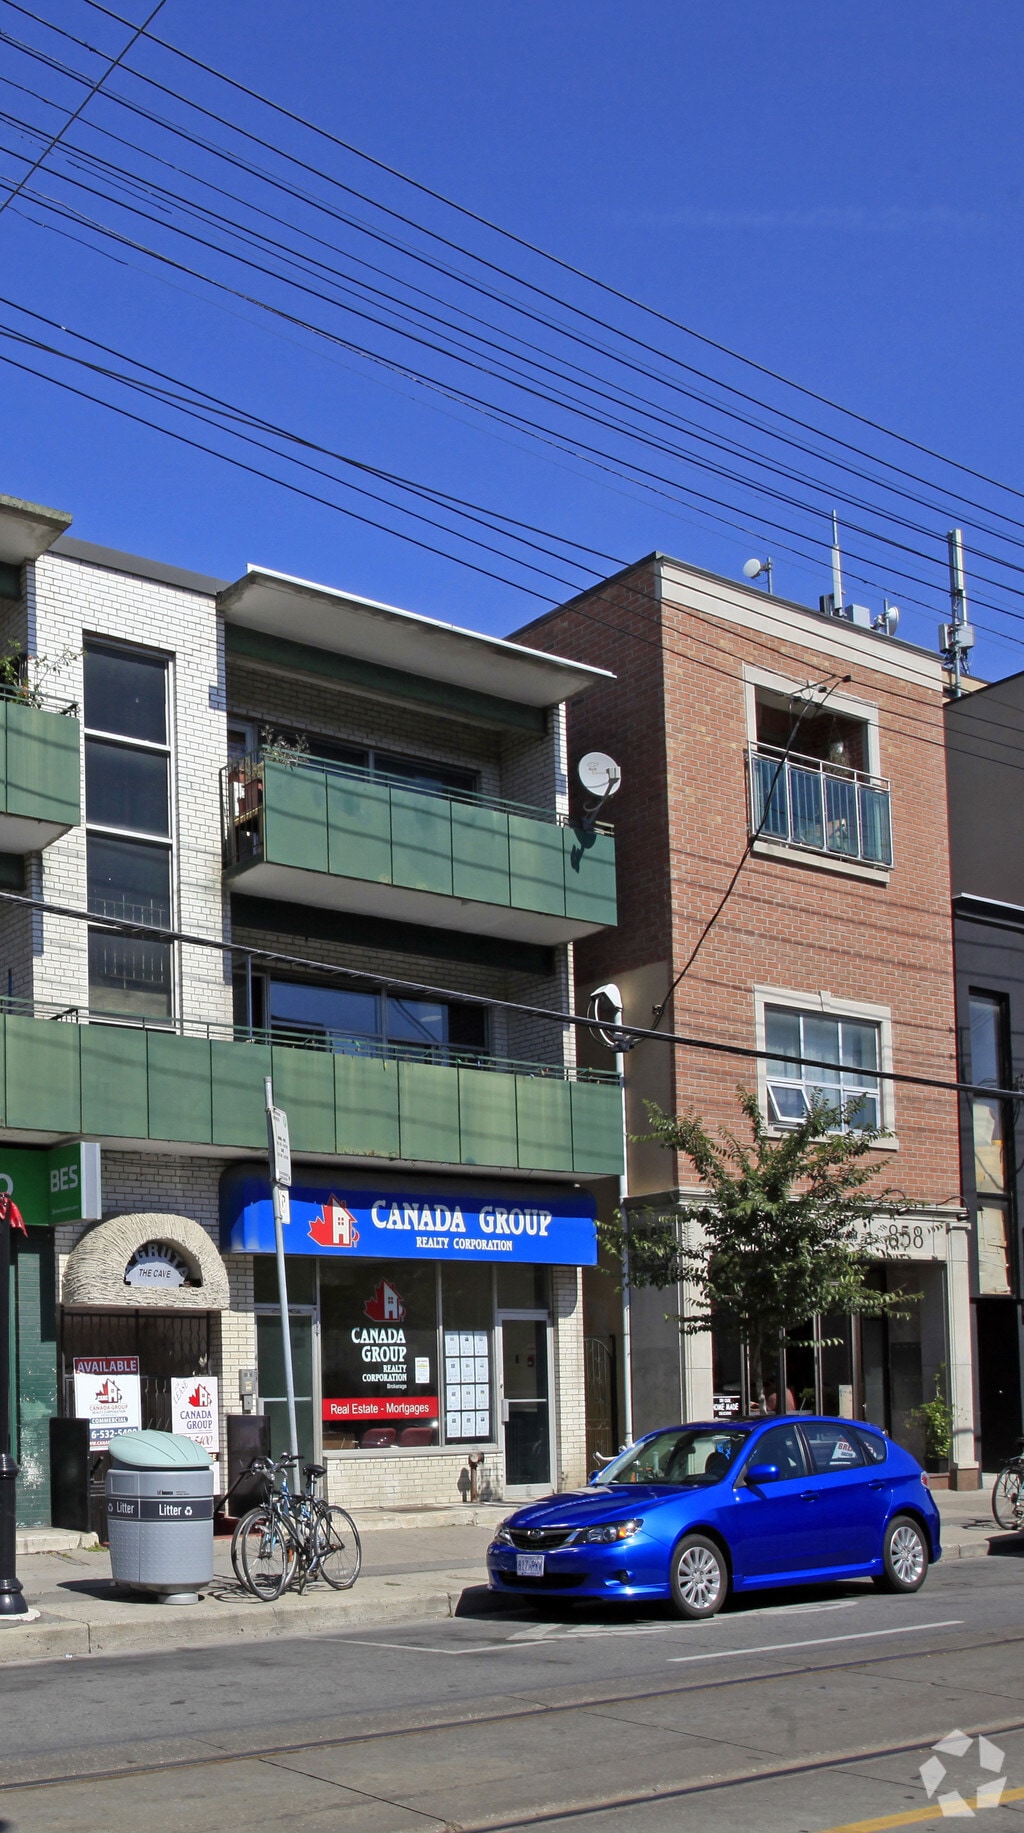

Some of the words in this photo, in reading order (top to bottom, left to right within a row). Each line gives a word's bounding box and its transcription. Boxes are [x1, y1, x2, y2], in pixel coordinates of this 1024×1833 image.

[50, 1165, 78, 1192] BES
[371, 1200, 466, 1232] CANADA
[479, 1206, 552, 1236] GROUP
[416, 1236, 449, 1249] REALTY
[454, 1238, 513, 1251] CORPORATION
[888, 1224, 923, 1249] 858
[139, 1268, 152, 1278] THE
[153, 1269, 171, 1278] CAVE
[351, 1327, 406, 1344] CANADA
[361, 1345, 407, 1362] GROUP
[77, 1360, 137, 1373] AVAILABLE
[383, 1364, 407, 1373] REALTY
[362, 1374, 407, 1382] CORPORATION
[180, 1410, 213, 1420] CANADA
[330, 1403, 350, 1415] Real
[352, 1403, 378, 1414] Estate
[386, 1402, 429, 1415] Mortgages
[187, 1420, 213, 1430] GROUP
[117, 1501, 134, 1514] Litter
[159, 1504, 182, 1516] Litter
